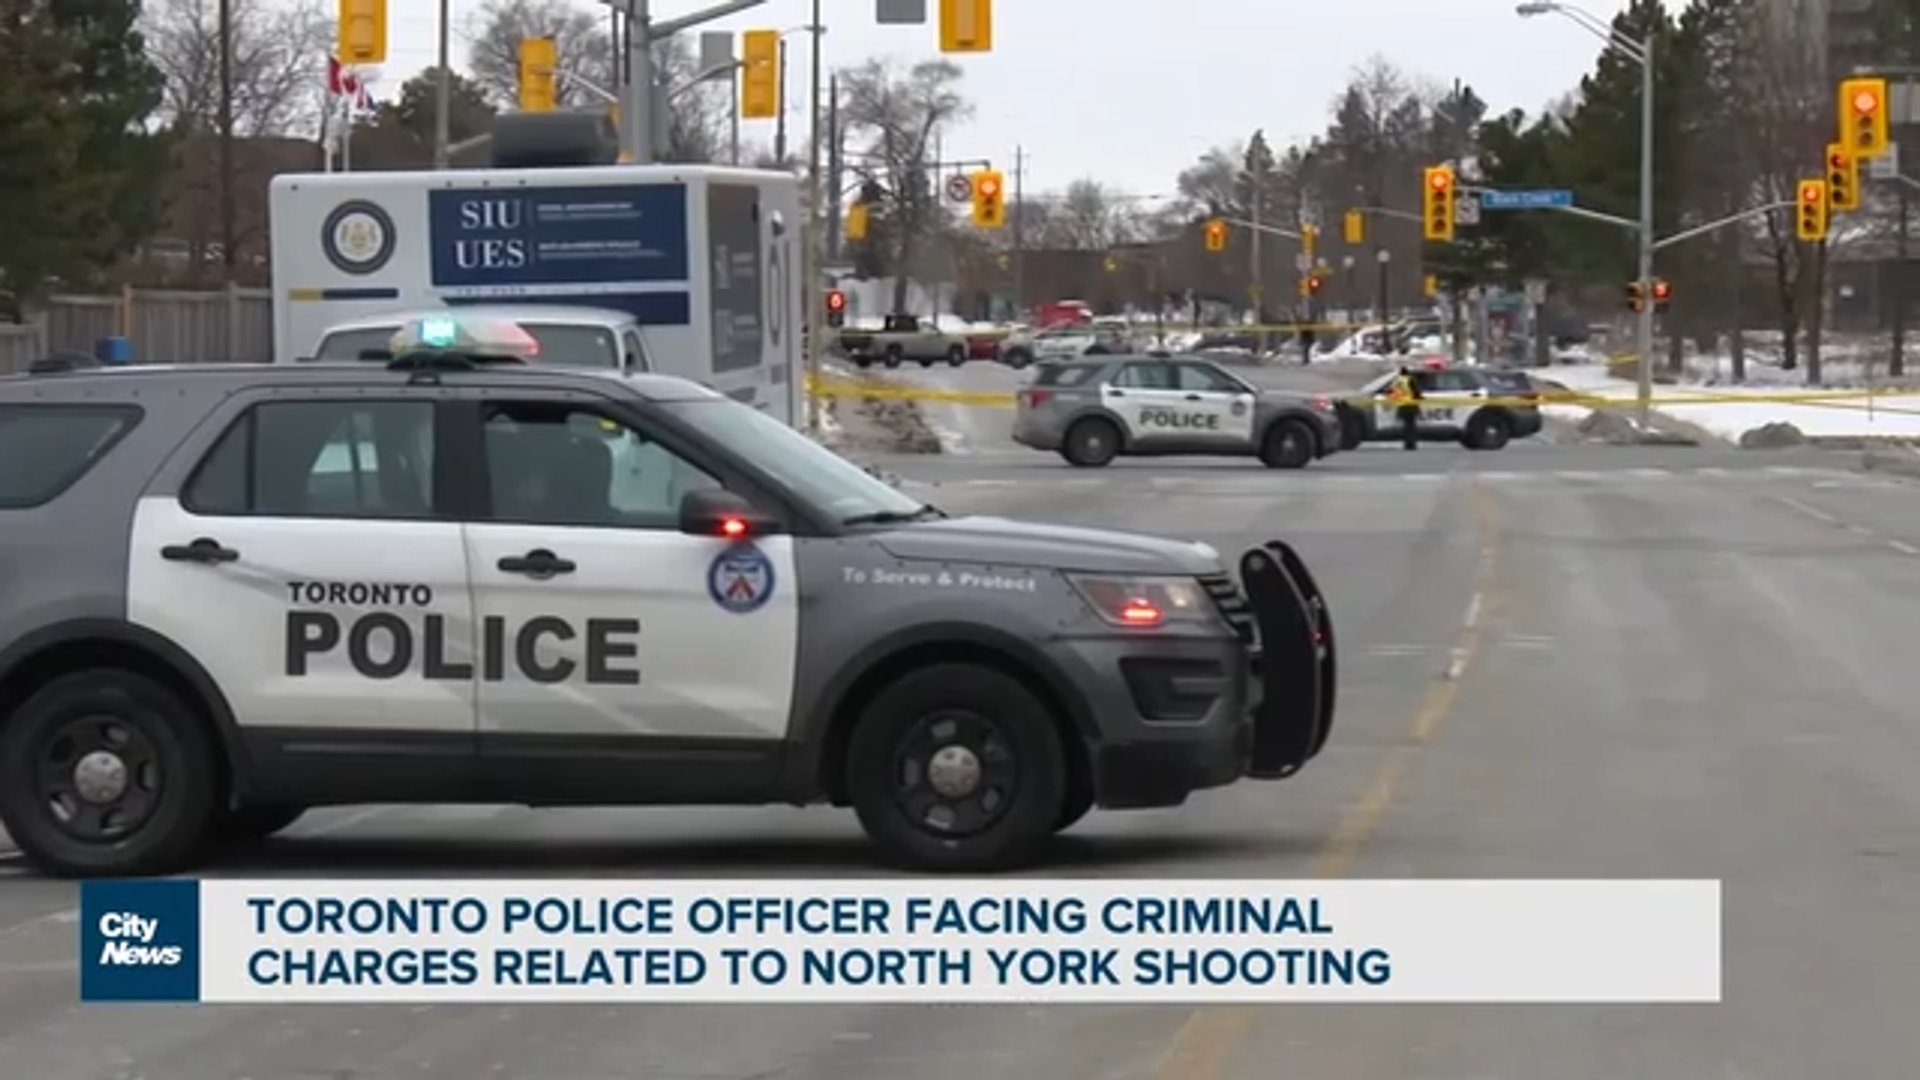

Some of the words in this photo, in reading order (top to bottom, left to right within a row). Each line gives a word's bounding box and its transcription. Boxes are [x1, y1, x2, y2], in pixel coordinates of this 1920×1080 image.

[460, 200, 521, 229] SIU
[455, 239, 525, 268] UES
[1139, 411, 1220, 430] POLICE
[842, 567, 866, 584] To
[870, 568, 931, 585] Serve
[936, 571, 952, 586] &
[959, 572, 1036, 592] Protect
[286, 581, 432, 607] TORONTO
[285, 610, 641, 685] POLICE
